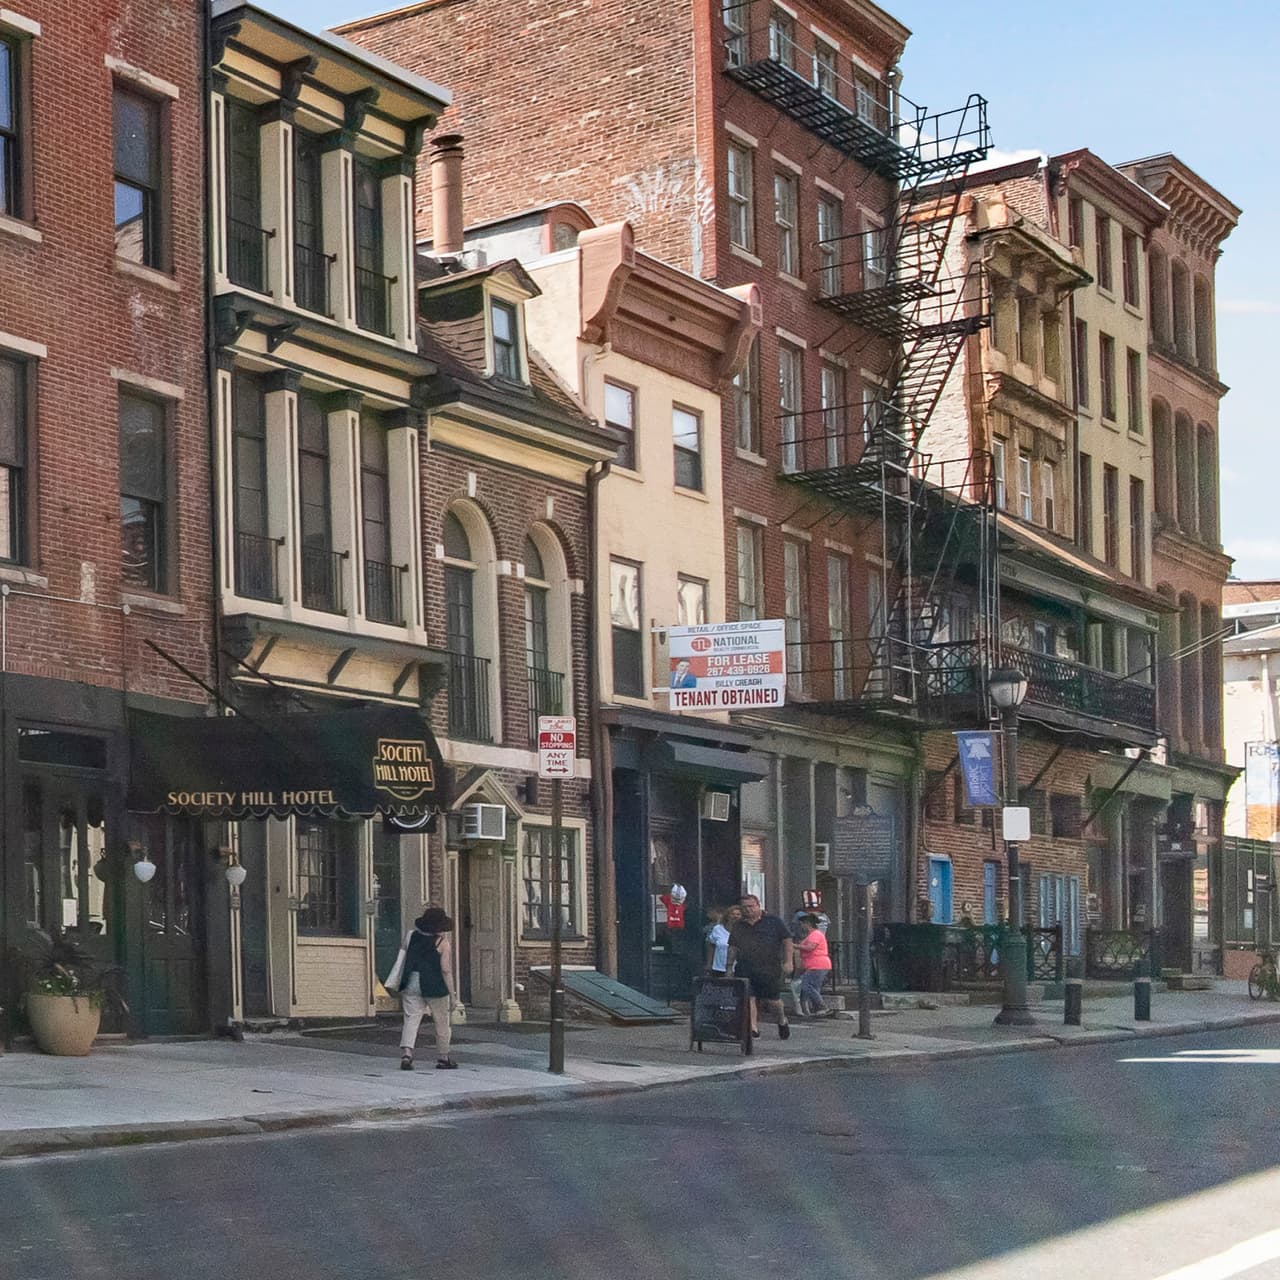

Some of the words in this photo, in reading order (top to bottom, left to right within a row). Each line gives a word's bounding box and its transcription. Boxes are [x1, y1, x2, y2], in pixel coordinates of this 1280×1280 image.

[713, 635, 760, 647] NATIONAL
[707, 656, 730, 666] FOR
[733, 653, 769, 665] LEASE
[674, 690, 718, 706] TENANT
[721, 688, 778, 705] OBTAINED
[550, 733, 564, 742] NO
[381, 744, 422, 762] SOCIETY
[375, 764, 398, 781] HILL
[398, 766, 432, 782] HOTEL
[167, 791, 236, 806] SOCIETY
[241, 791, 277, 806] HILL
[282, 790, 338, 805] HOTEL
